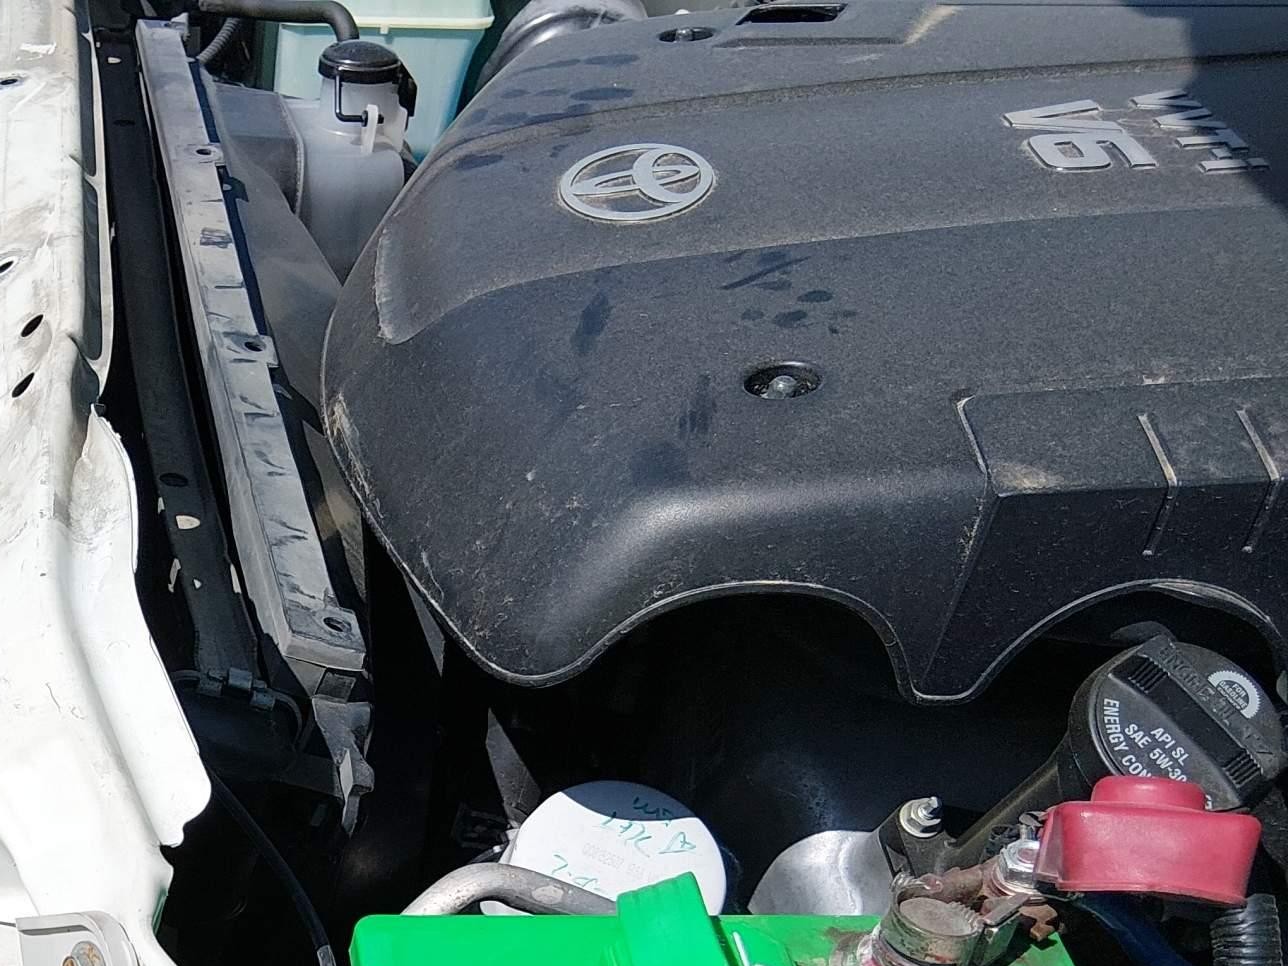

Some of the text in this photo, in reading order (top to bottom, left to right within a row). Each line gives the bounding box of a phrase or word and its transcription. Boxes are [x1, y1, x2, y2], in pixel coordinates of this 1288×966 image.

[1003, 99, 1158, 171] V6
[1103, 698, 1152, 778] ENERGY CON
[1124, 722, 1152, 749] SAE
[1150, 726, 1191, 767] API SL
